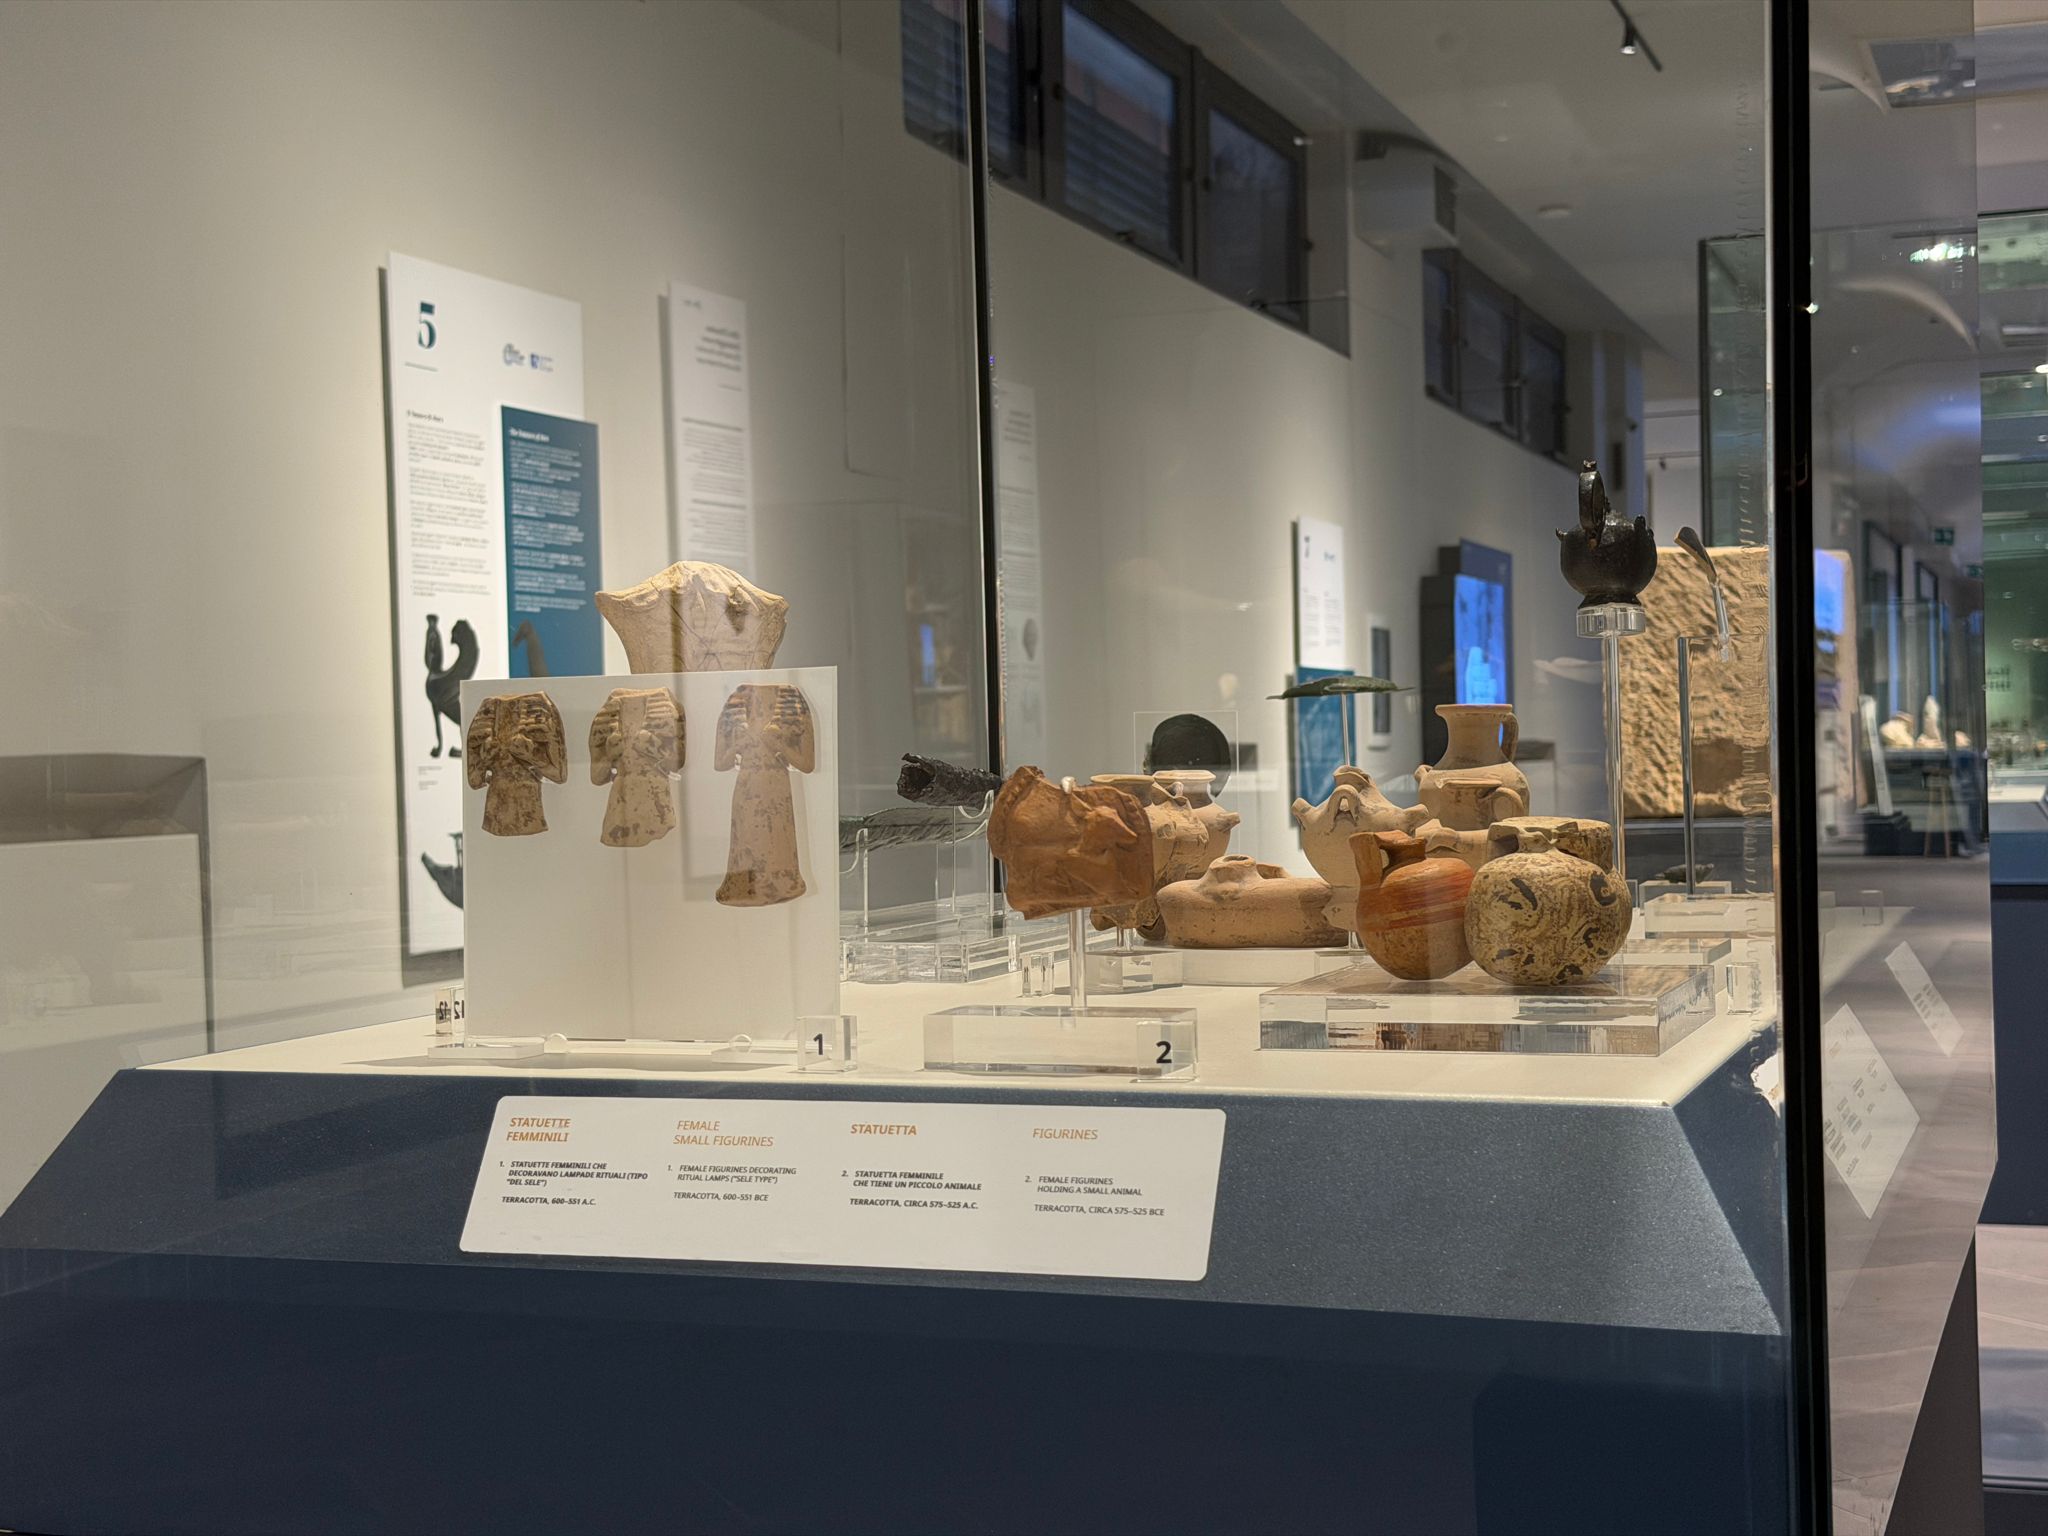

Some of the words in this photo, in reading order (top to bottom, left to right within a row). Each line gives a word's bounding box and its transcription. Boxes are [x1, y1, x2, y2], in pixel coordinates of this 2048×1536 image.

[418, 301, 437, 349] 5
[813, 1033, 823, 1055] 1
[1156, 1040, 1172, 1064] 2
[509, 1117, 571, 1128] STATUETTE
[676, 1120, 720, 1131] FEMALE
[850, 1124, 917, 1136] STATUETTA
[1032, 1128, 1098, 1140] FIGURINES
[506, 1131, 569, 1142] FEMMINILI
[672, 1134, 710, 1146] SMALL
[713, 1135, 774, 1147] FIGURINES
[510, 1160, 550, 1168] STATUETTE
[550, 1161, 592, 1170] FEMMINILI
[592, 1162, 607, 1170] CHE
[679, 1164, 708, 1173] FEMALE
[708, 1165, 748, 1174] FIGURINES
[748, 1166, 797, 1175] DECORATING
[508, 1169, 558, 1178] DECORAVANO
[559, 1170, 595, 1179] LAMPADE
[595, 1171, 626, 1180] RITUALI
[626, 1172, 648, 1181] (TIPO
[677, 1173, 704, 1182] RITUAL
[704, 1174, 730, 1183] LAMPS
[841, 1170, 849, 1178] 2.
[855, 1170, 898, 1179] STATUETTA
[898, 1171, 944, 1180] FEMMINILE
[1038, 1175, 1070, 1184] FEMALE
[1070, 1176, 1114, 1186] FIGURINES
[852, 1179, 869, 1187] CHE
[870, 1180, 894, 1188] TIENE
[894, 1181, 907, 1189] UN
[908, 1181, 944, 1190] PICCOLO
[944, 1182, 982, 1191] ANIMALE
[1037, 1185, 1075, 1194] HOLDING
[1082, 1186, 1110, 1195] SMALL
[1110, 1187, 1142, 1196] ANIMAL
[502, 1196, 549, 1205] TERRACOTTA,
[673, 1191, 721, 1201] TERRACOTTA,
[753, 1193, 769, 1202] BCE
[849, 1198, 902, 1208] TERRACOTTA,
[903, 1199, 928, 1208] CIRCA
[1033, 1204, 1087, 1214] TERRACOTTA,
[1088, 1206, 1113, 1214] CIRCA
[1148, 1208, 1165, 1216] BCE
